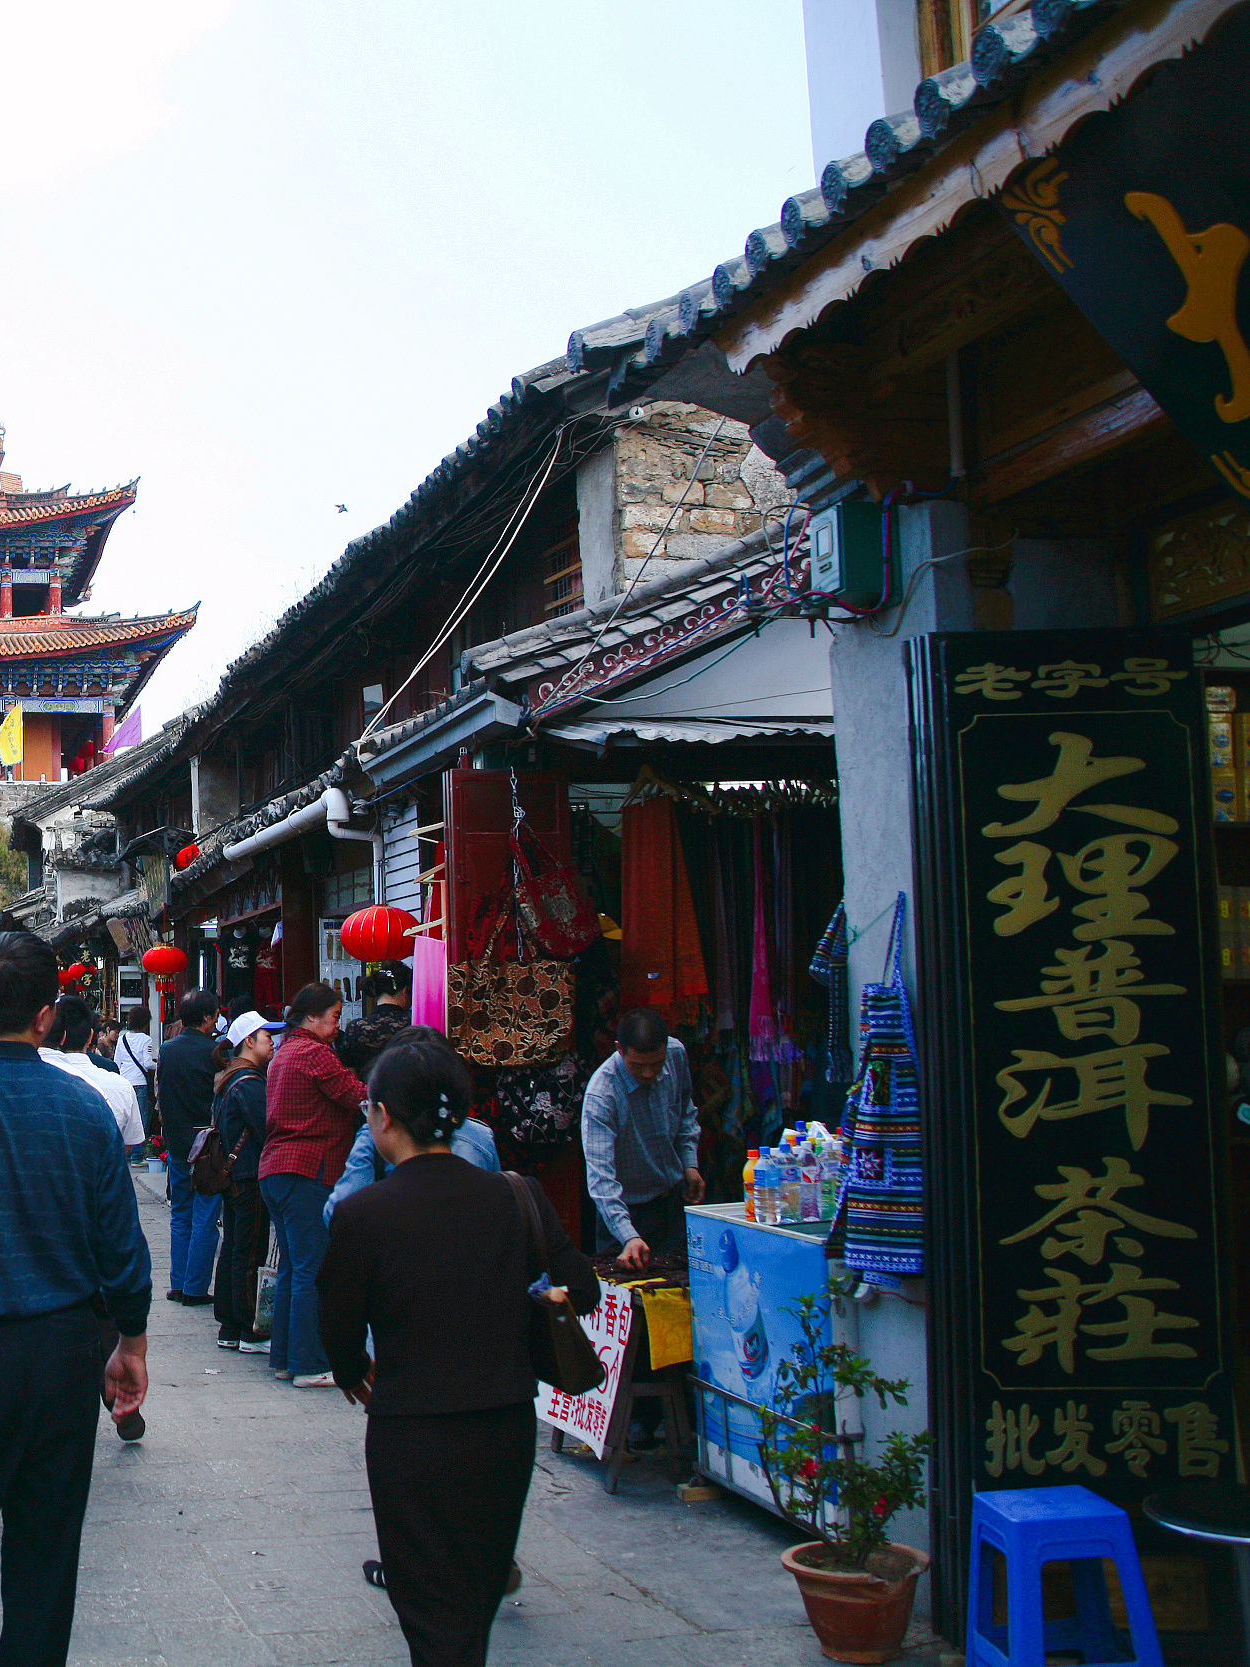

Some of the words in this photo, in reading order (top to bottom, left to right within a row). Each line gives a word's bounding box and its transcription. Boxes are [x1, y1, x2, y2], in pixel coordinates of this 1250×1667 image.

[954, 657, 1188, 700] 老字号
[984, 1400, 1229, 1478] 批发零售
